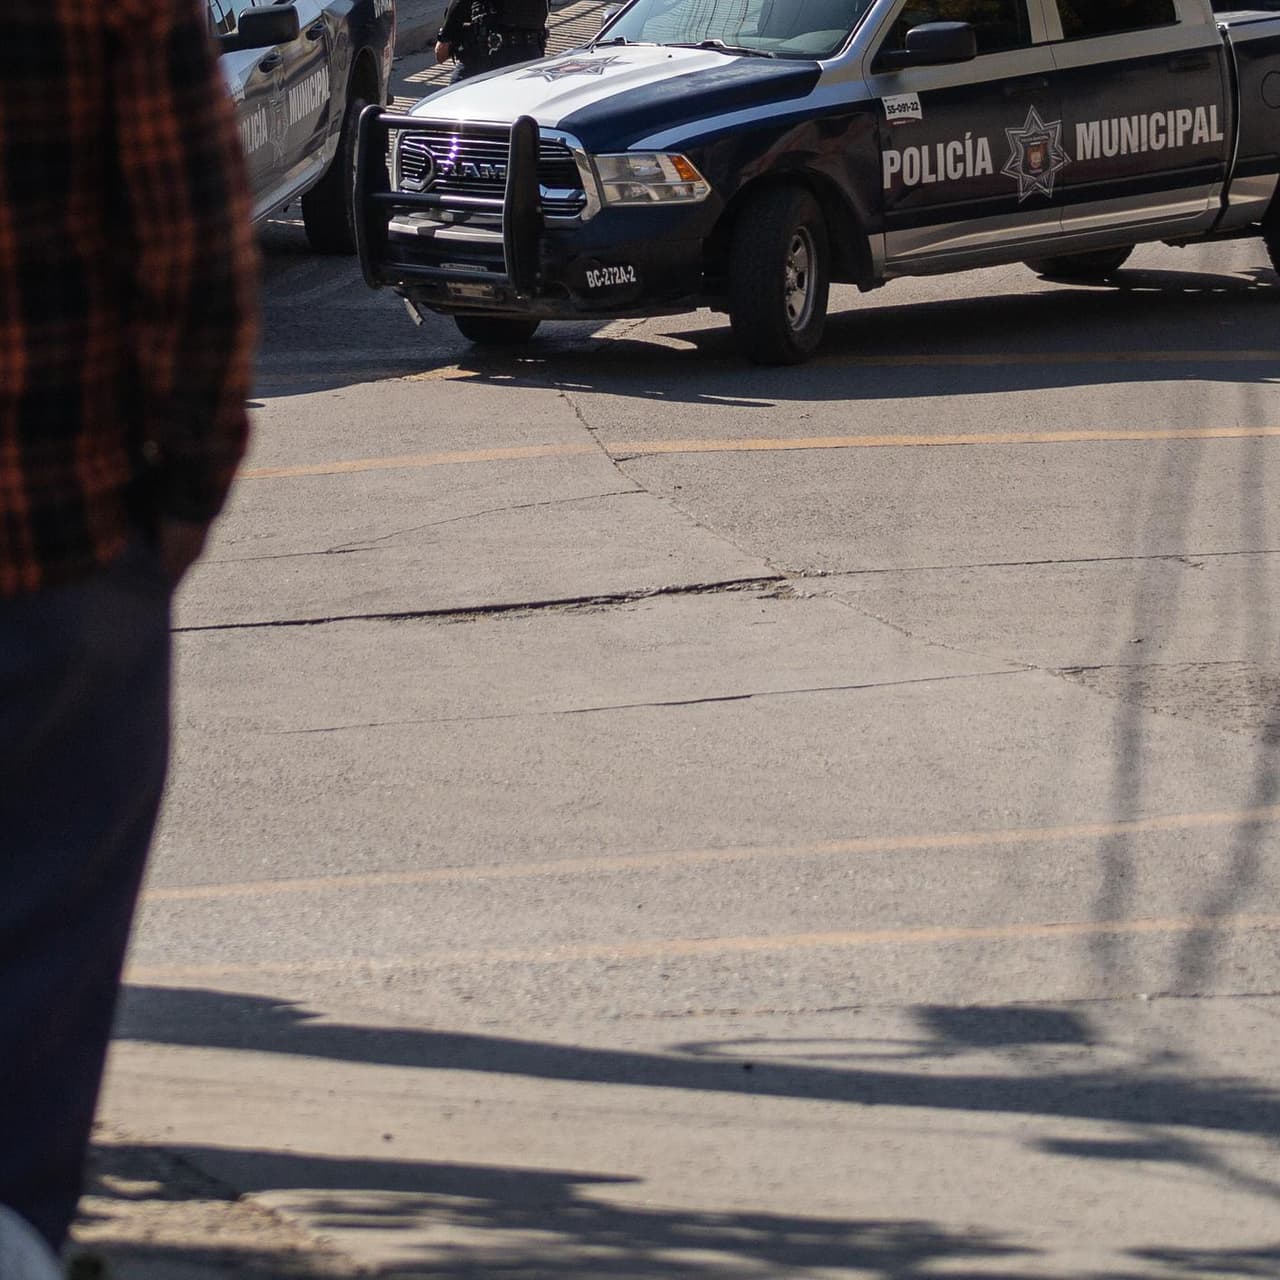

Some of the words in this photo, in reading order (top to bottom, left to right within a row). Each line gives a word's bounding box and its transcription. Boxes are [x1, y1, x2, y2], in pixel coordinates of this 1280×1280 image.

[288, 64, 331, 126] MUNICIPAL
[882, 131, 993, 189] POLICÍA
[1075, 105, 1224, 161] MUNICIPAL
[586, 266, 637, 288] BC-272A-2
